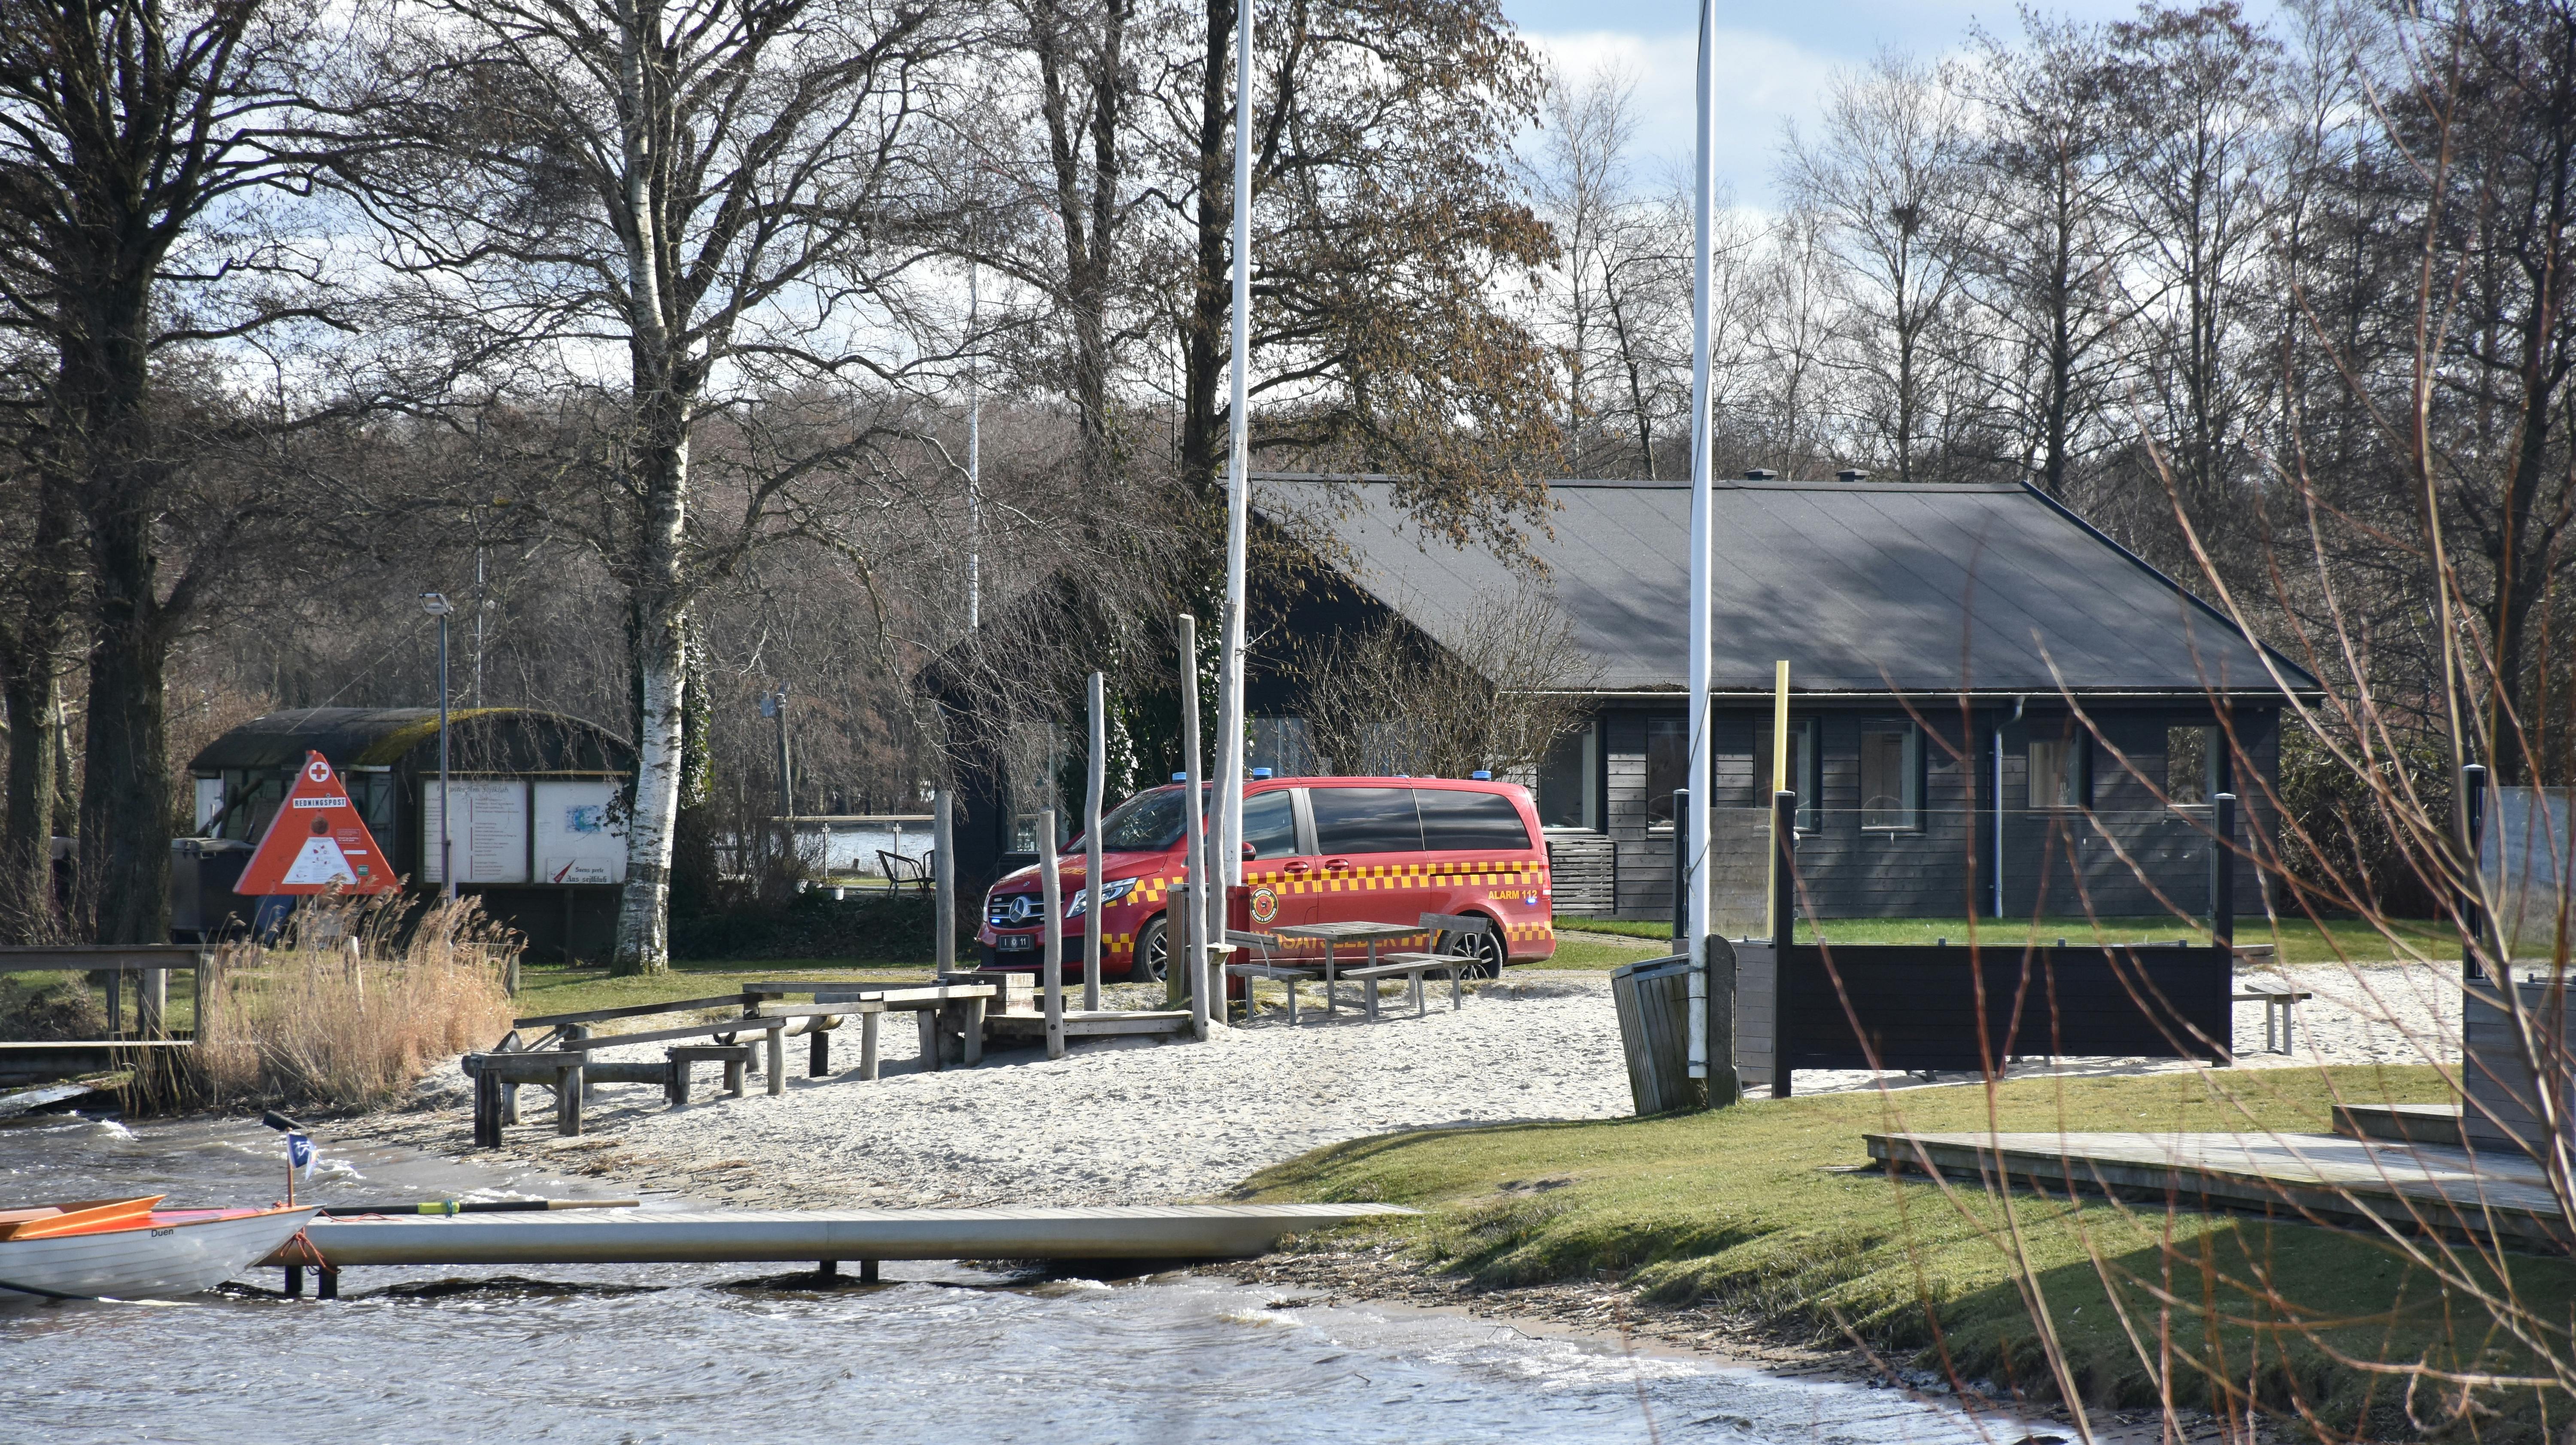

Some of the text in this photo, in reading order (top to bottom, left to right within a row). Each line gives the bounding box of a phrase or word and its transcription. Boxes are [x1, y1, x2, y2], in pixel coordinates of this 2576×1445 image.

[1488, 890, 1537, 900] ALARM 112
[151, 1229, 174, 1237] Duen
